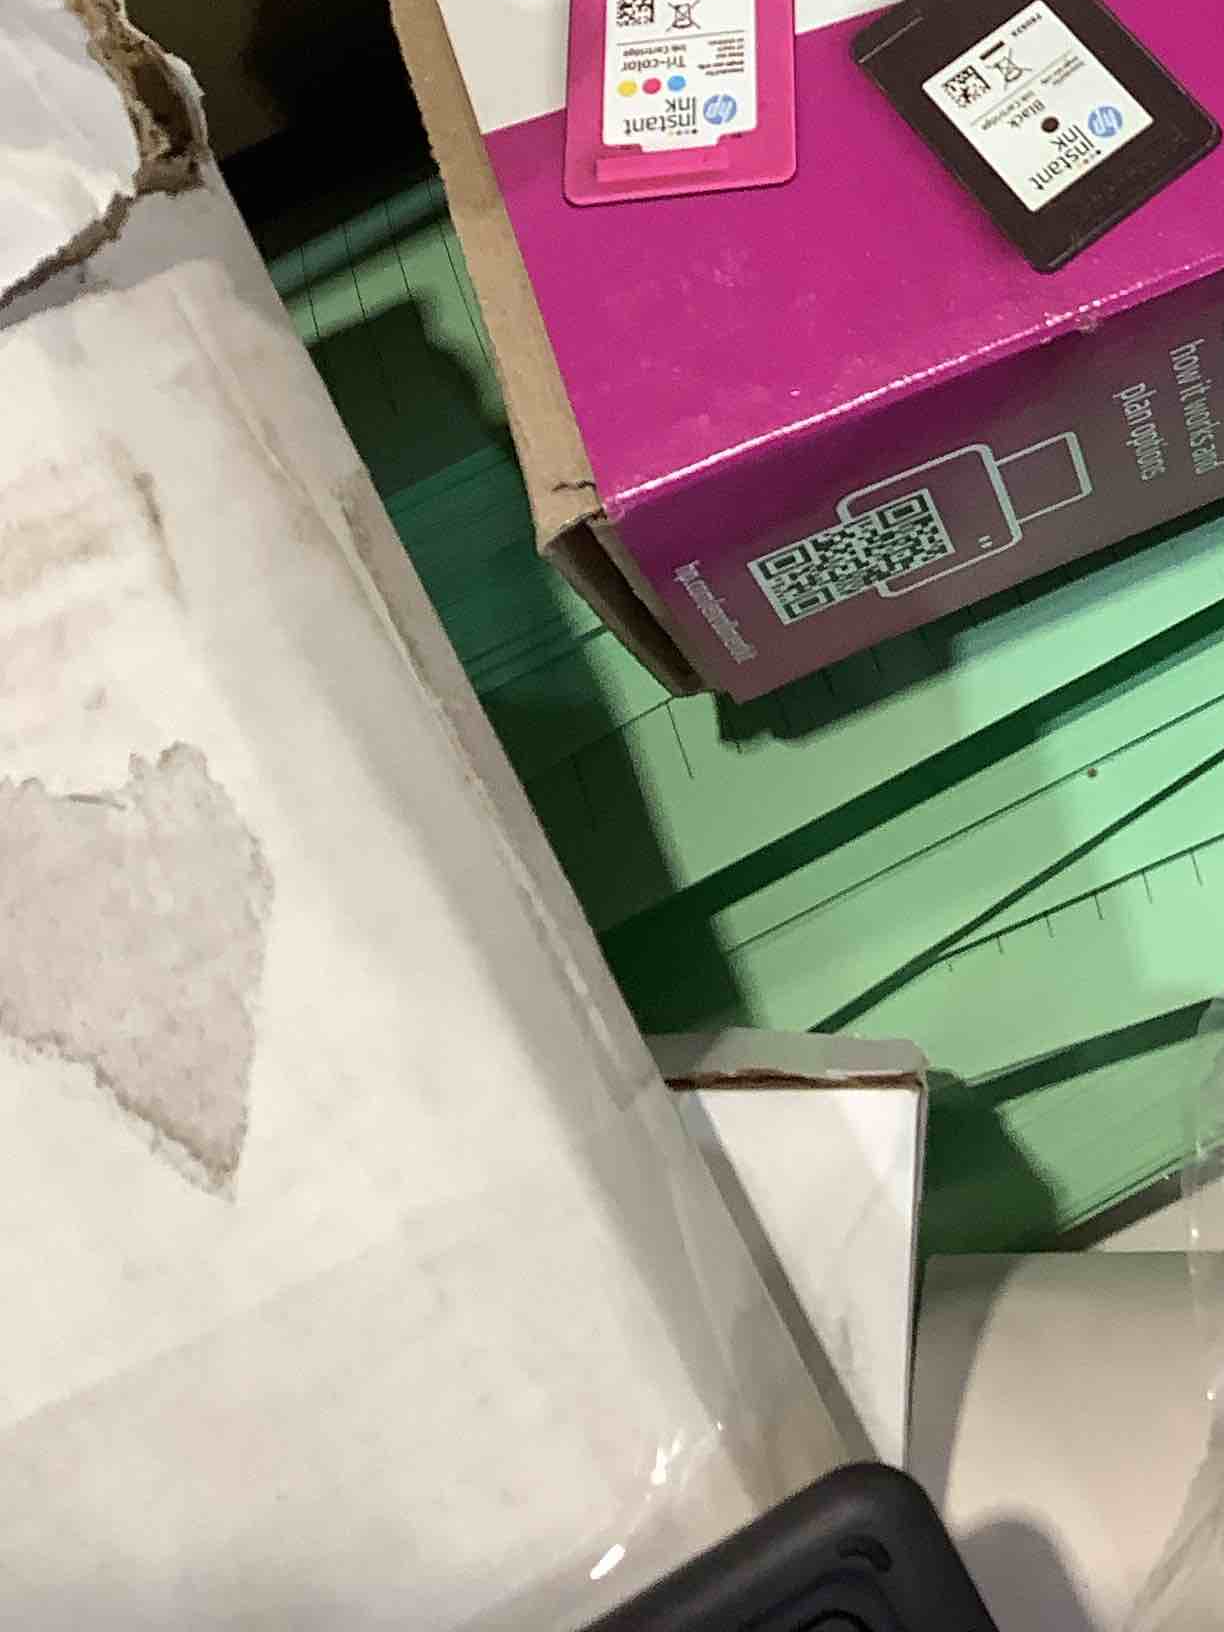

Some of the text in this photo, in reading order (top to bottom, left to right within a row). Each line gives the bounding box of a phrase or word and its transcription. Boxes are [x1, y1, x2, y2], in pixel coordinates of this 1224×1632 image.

[620, 54, 686, 73] Tri-color
[1010, 99, 1045, 129] Black
[1169, 338, 1205, 385] how
[1179, 378, 1213, 403] it
[1112, 382, 1169, 481] plan options
[1183, 396, 1221, 448] works
